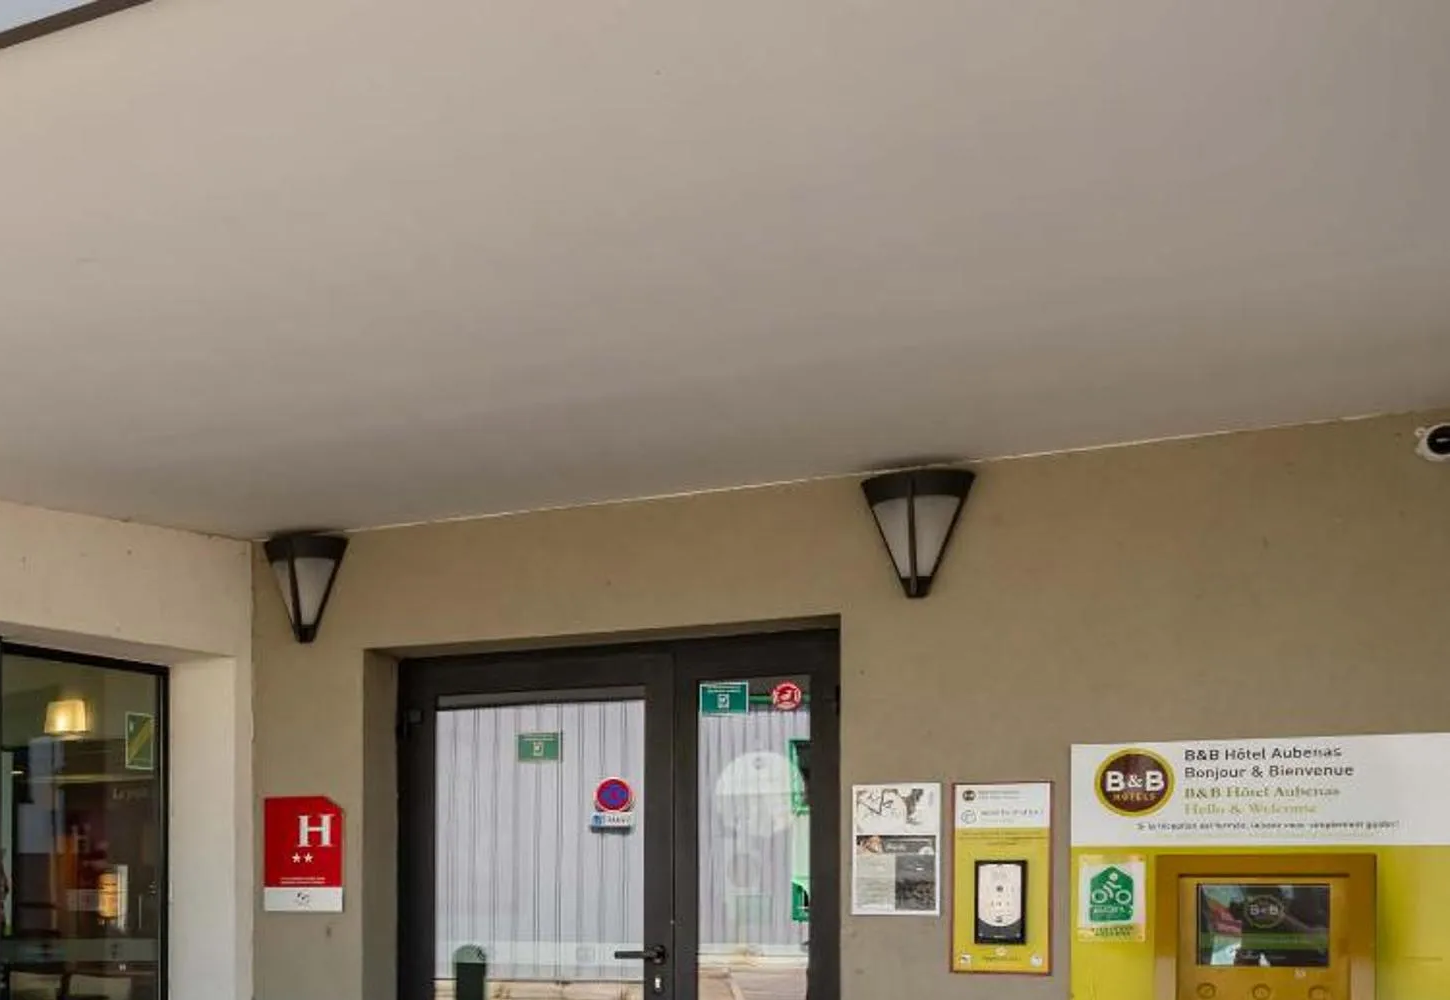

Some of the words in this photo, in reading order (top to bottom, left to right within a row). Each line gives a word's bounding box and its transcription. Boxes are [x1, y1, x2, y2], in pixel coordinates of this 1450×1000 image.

[1184, 748, 1219, 761] B&B
[1225, 747, 1266, 761] Hôtel
[1271, 747, 1343, 759] Aubenas
[1184, 766, 1246, 781] Bonjour
[1251, 765, 1263, 778] &
[1269, 765, 1355, 777] Bienvenue
[1106, 771, 1165, 792] B&B
[1184, 786, 1221, 799] B&B
[1226, 785, 1269, 798] Hôtel
[297, 813, 335, 848] H
